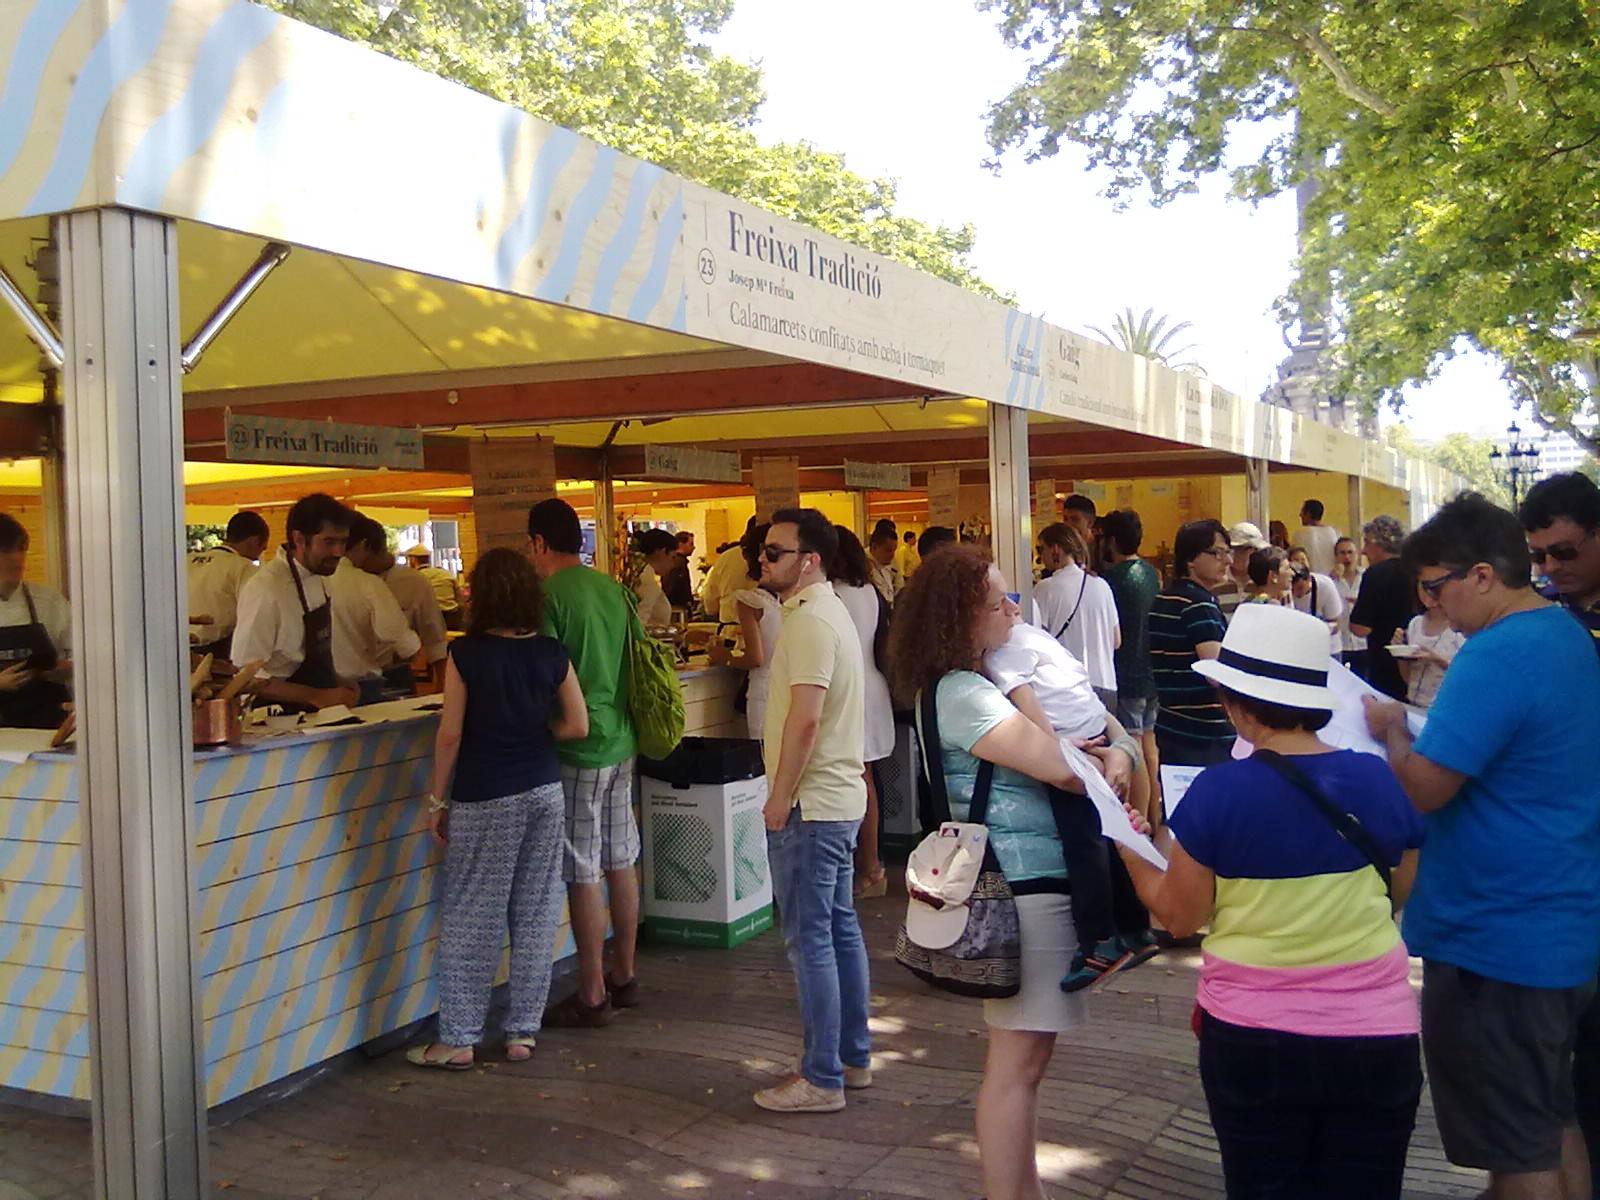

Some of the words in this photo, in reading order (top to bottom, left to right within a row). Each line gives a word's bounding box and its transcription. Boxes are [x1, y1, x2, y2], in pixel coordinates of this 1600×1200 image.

[700, 256, 714, 277] 23
[728, 210, 799, 273] Freixa
[803, 238, 882, 299] Tradició
[728, 269, 755, 292] Josep
[769, 277, 795, 301] Freixa
[730, 300, 808, 342] Calamarcets
[808, 325, 856, 354] confitats
[857, 337, 879, 359] amb
[254, 428, 307, 451] Freixa
[311, 432, 378, 455] Tradició
